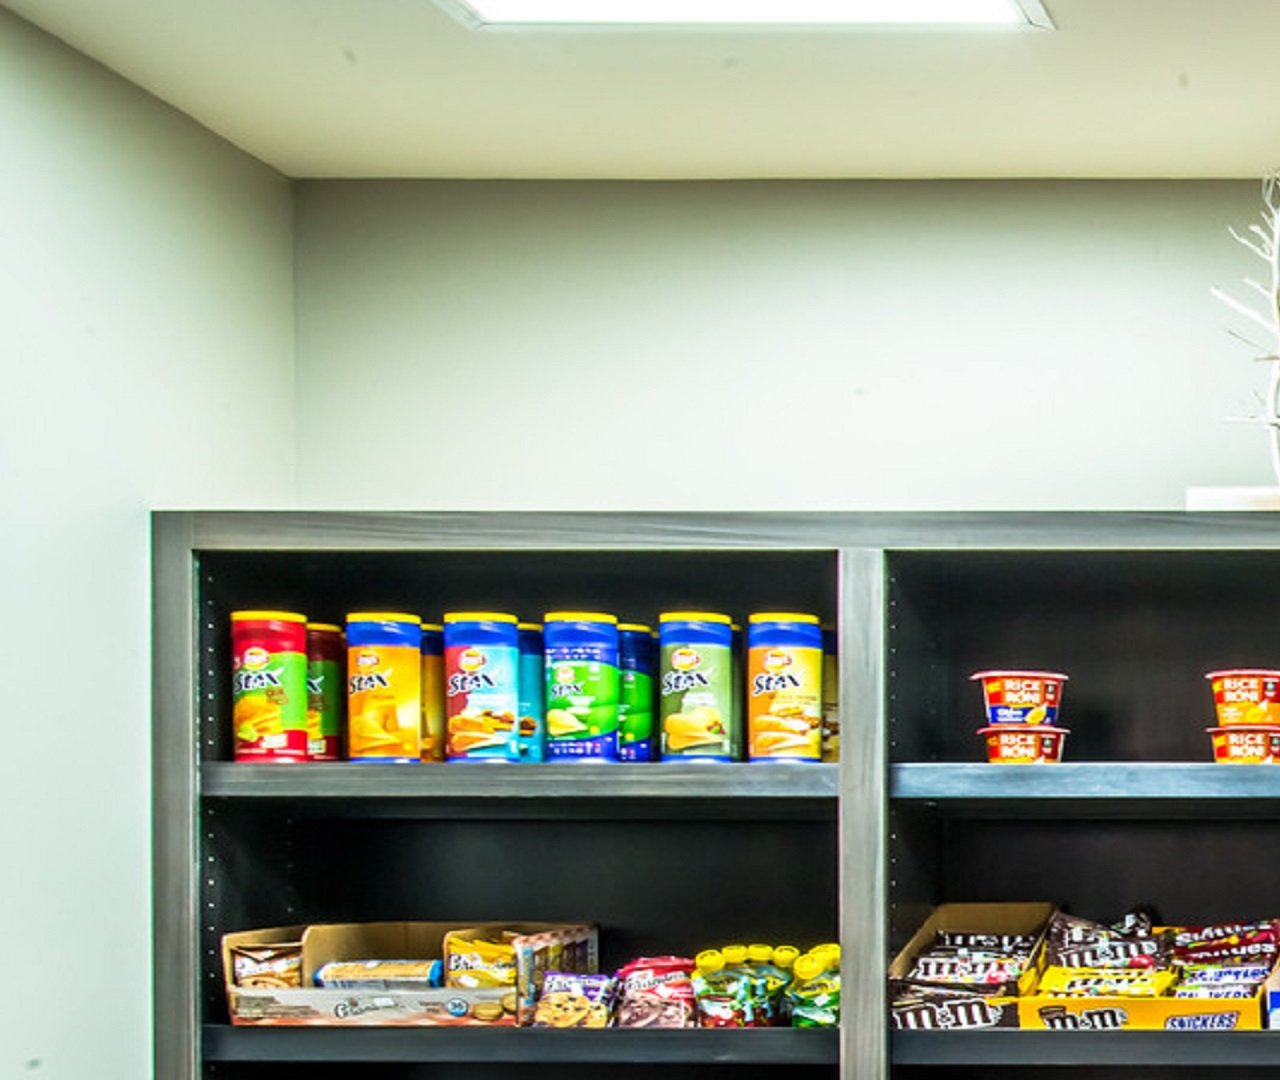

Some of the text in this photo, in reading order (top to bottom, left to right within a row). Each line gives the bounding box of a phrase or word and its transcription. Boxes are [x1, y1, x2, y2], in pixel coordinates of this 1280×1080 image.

[1004, 679, 1040, 691] RICE
[1223, 679, 1259, 691] RICE
[1000, 735, 1036, 746] RICE
[1228, 735, 1265, 746] RICE
[1170, 1012, 1237, 1029] SNICKERS
